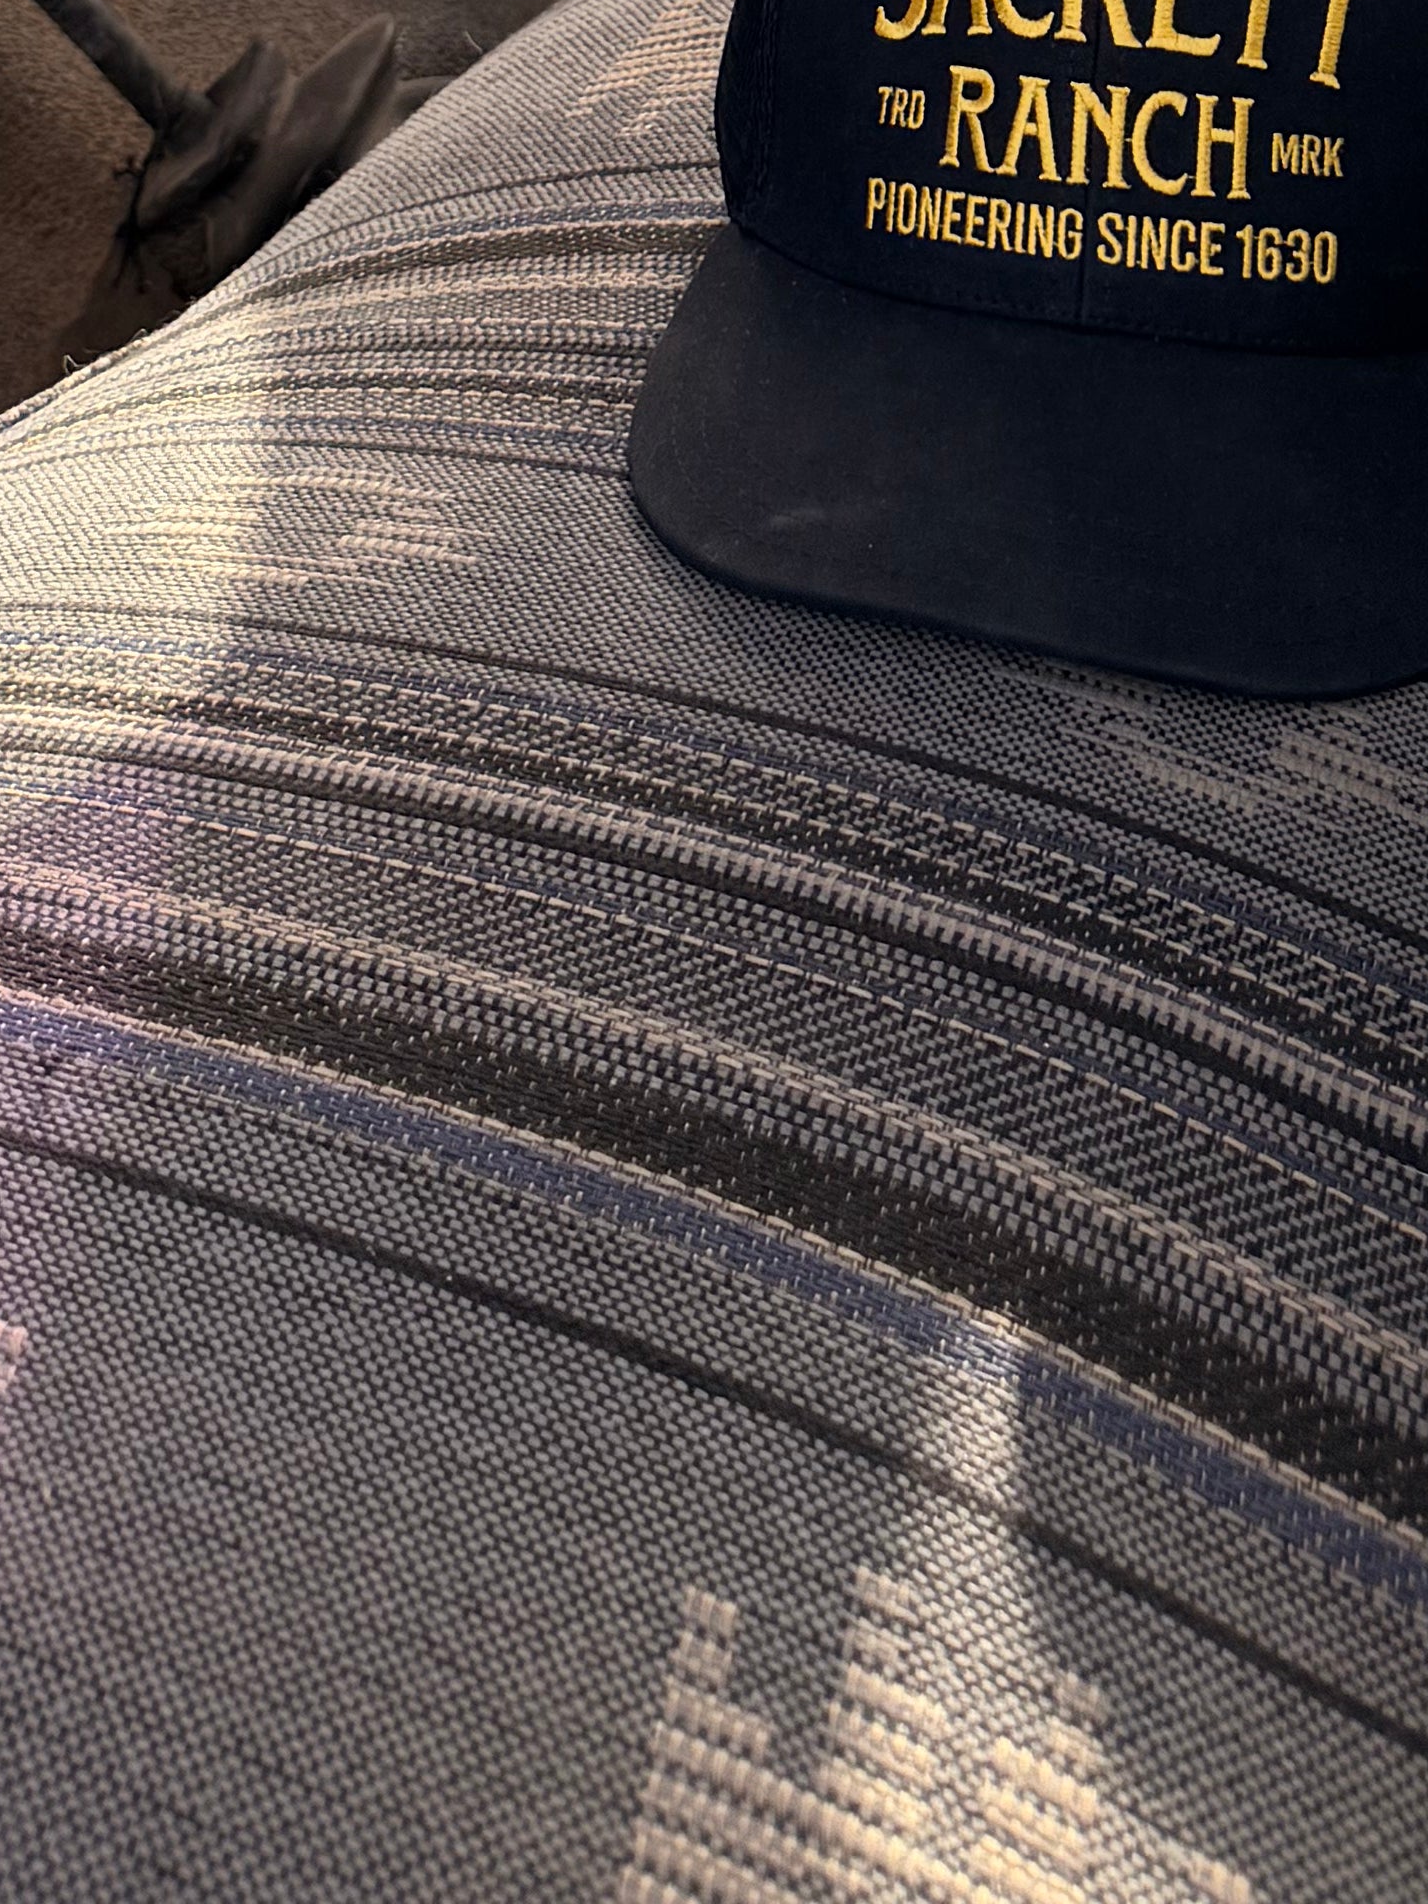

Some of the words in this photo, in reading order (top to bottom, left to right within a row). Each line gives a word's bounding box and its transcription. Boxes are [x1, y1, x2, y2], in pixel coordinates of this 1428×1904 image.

[877, 86, 925, 132] TRD
[939, 65, 1256, 200] RANCH
[1272, 132, 1345, 178] MRK
[866, 177, 1084, 261] PIONEERING
[1097, 212, 1225, 276] SINCE
[1236, 224, 1339, 285] 1630
